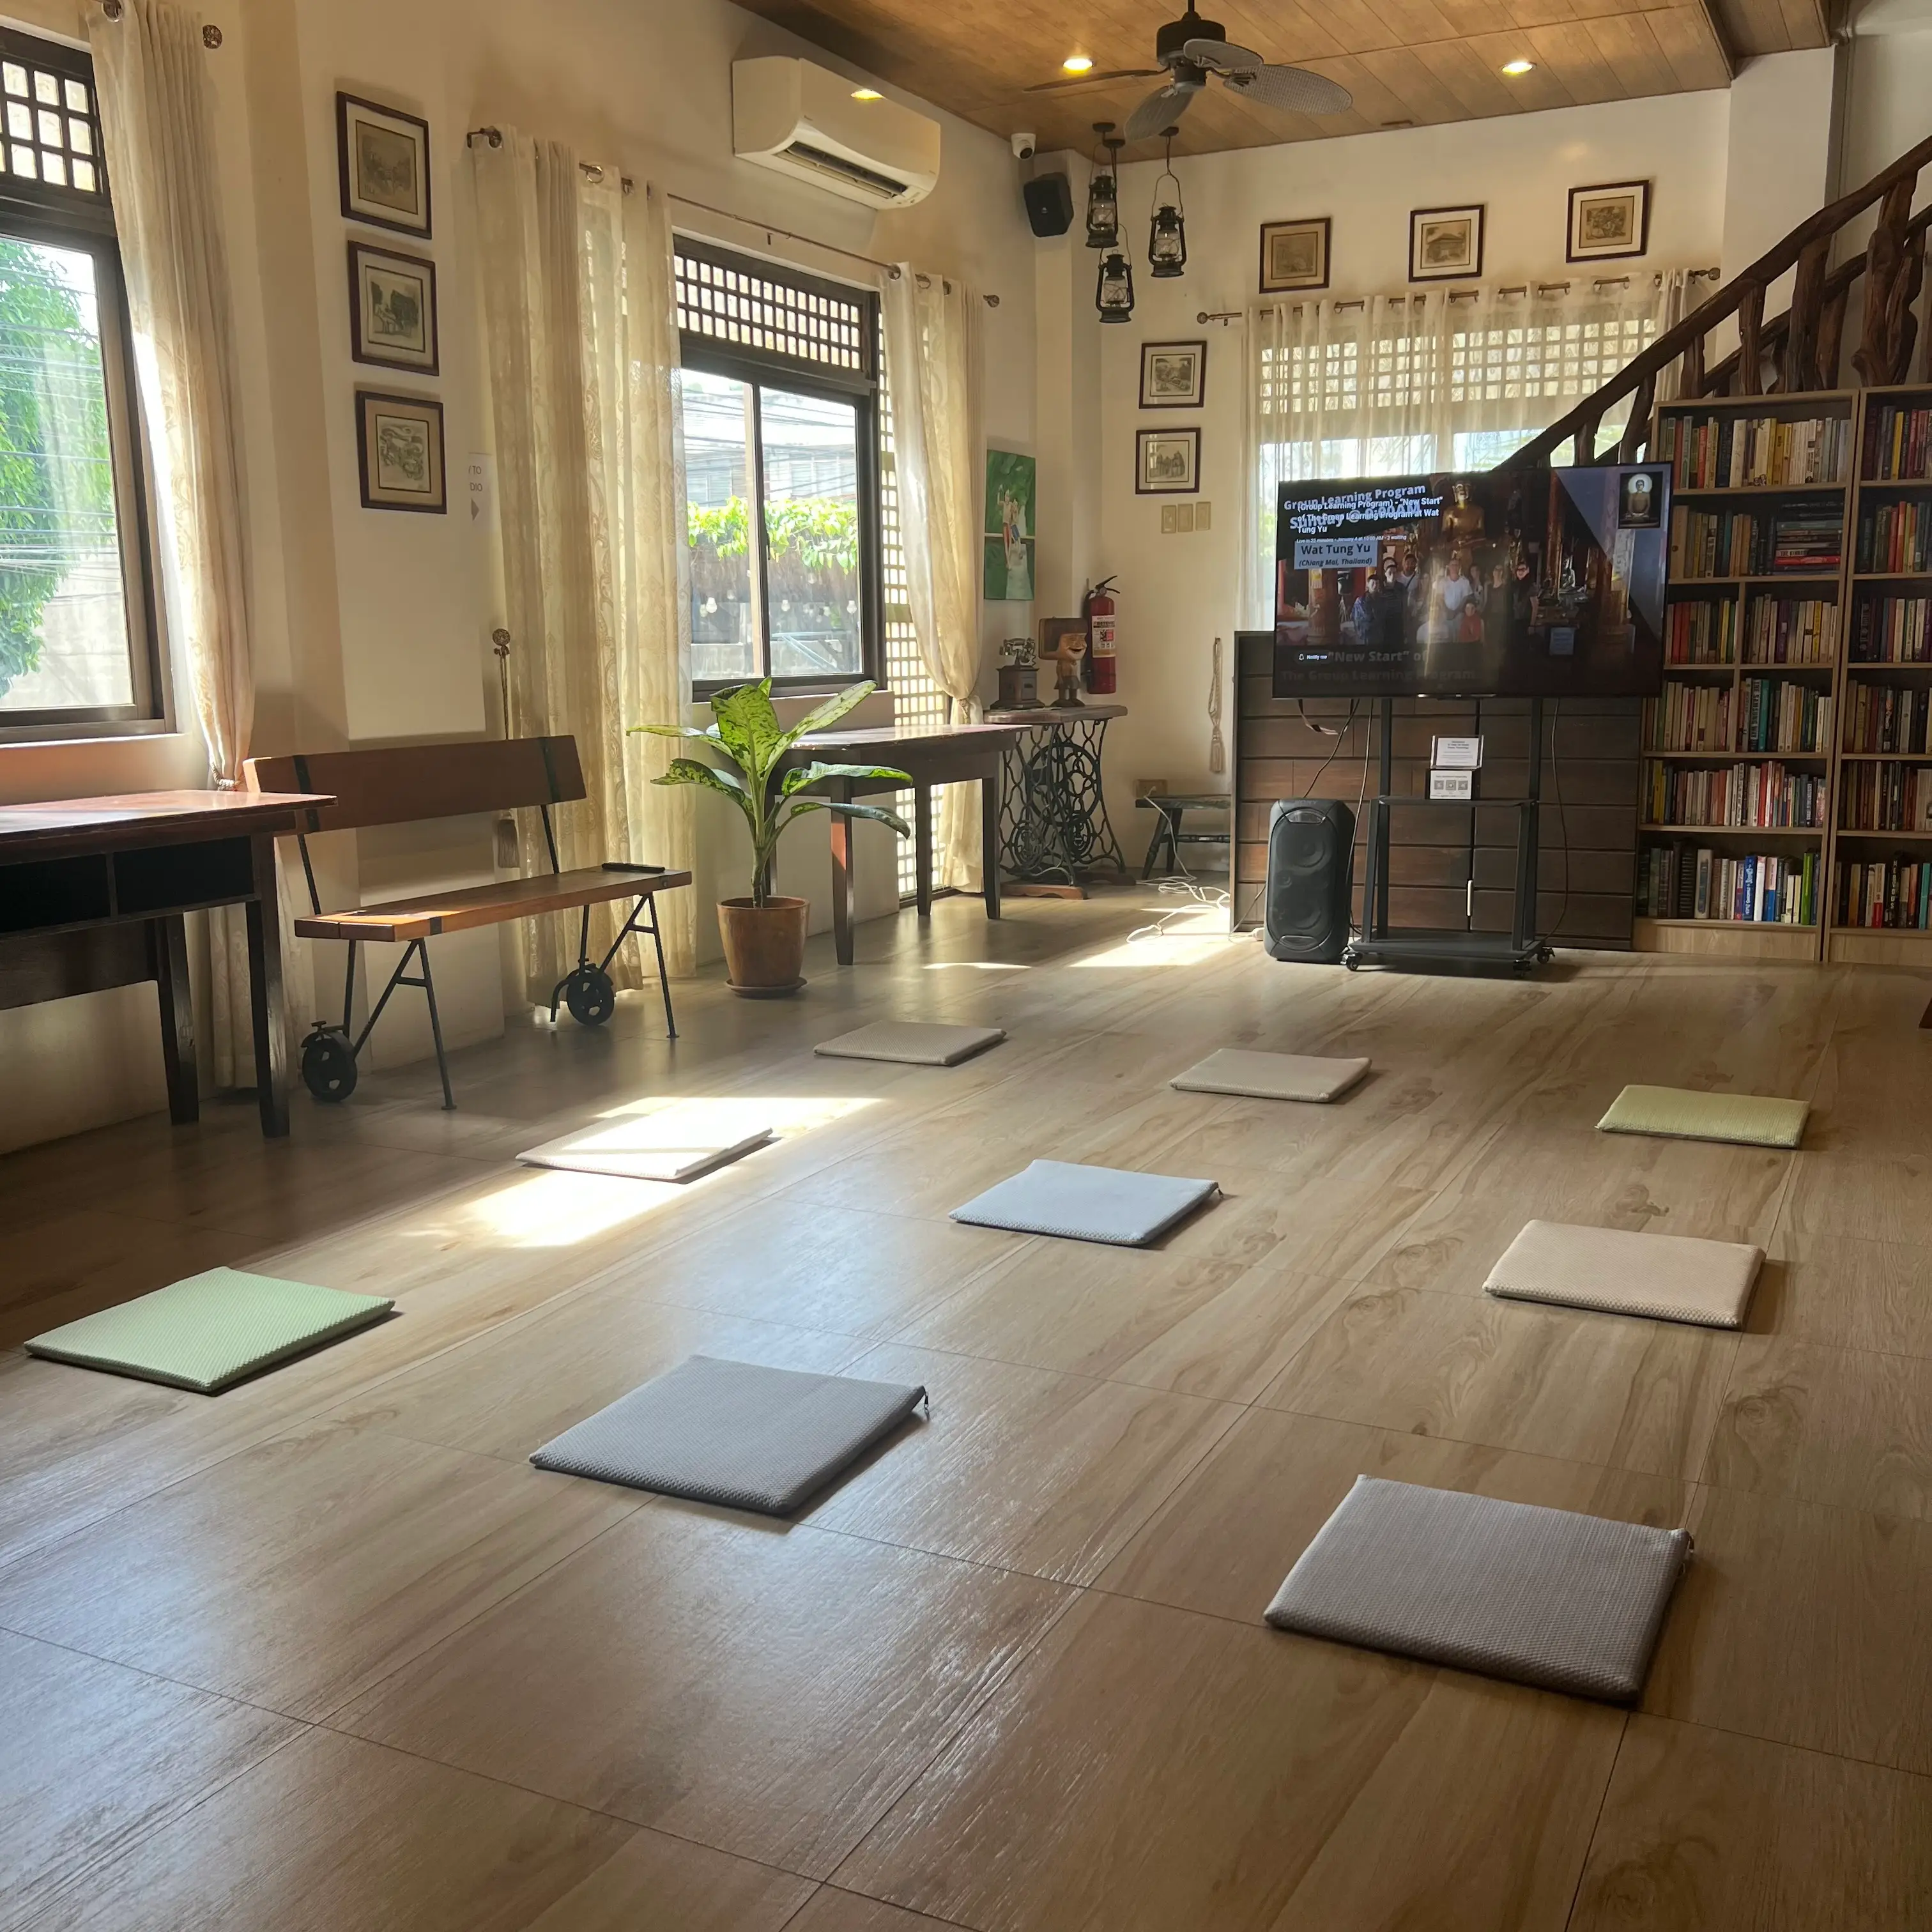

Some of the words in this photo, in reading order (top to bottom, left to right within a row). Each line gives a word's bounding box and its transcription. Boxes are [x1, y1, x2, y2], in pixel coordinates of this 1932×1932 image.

[472, 466, 482, 475] TO
[1284, 499, 1318, 510] Group
[1321, 491, 1372, 507] Learning
[1376, 485, 1425, 500] Program
[1298, 503, 1322, 512] (Group
[1324, 500, 1356, 510] Learning
[1358, 499, 1393, 509] Program)
[1422, 496, 1443, 505] Start"
[1322, 513, 1344, 522] Group
[1346, 511, 1378, 521] Learning
[1379, 510, 1412, 520] Program
[1424, 509, 1439, 517] Wat
[1297, 525, 1316, 535] Tung
[1301, 545, 1323, 555] Wat
[1326, 544, 1354, 556] Tung
[1356, 543, 1370, 553] Yu
[1299, 559, 1323, 567] (Chiang
[1328, 651, 1364, 662] "New
[1368, 650, 1409, 662] Start"
[1282, 671, 1305, 681] The
[1309, 670, 1349, 682] Group
[1353, 670, 1412, 682] Learning
